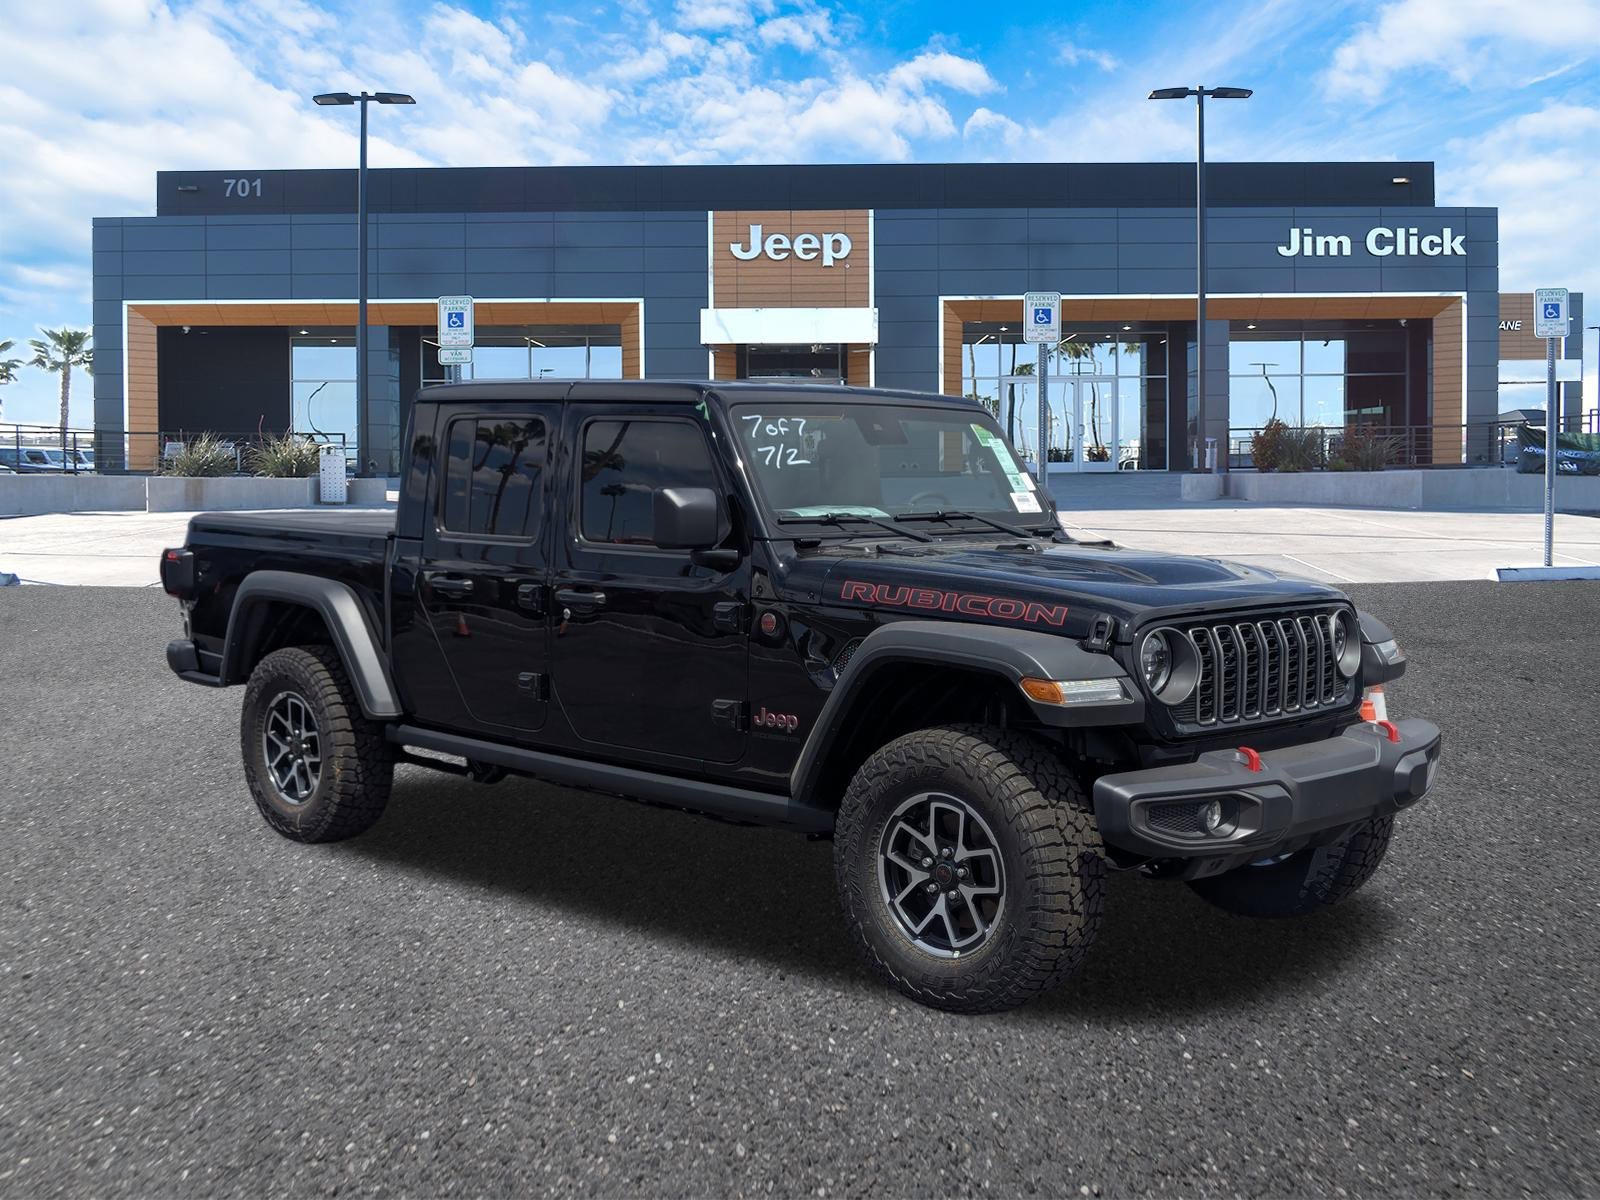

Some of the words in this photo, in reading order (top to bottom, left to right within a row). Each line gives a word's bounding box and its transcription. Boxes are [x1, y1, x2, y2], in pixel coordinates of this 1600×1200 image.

[223, 178, 262, 197] 701
[729, 224, 853, 268] Jeep
[1277, 227, 1352, 257] Jim
[1365, 226, 1467, 257] Click
[741, 414, 763, 438] 7
[757, 443, 811, 469] 7/2
[840, 580, 1069, 626] RUBICON
[753, 706, 799, 734] Jeep
